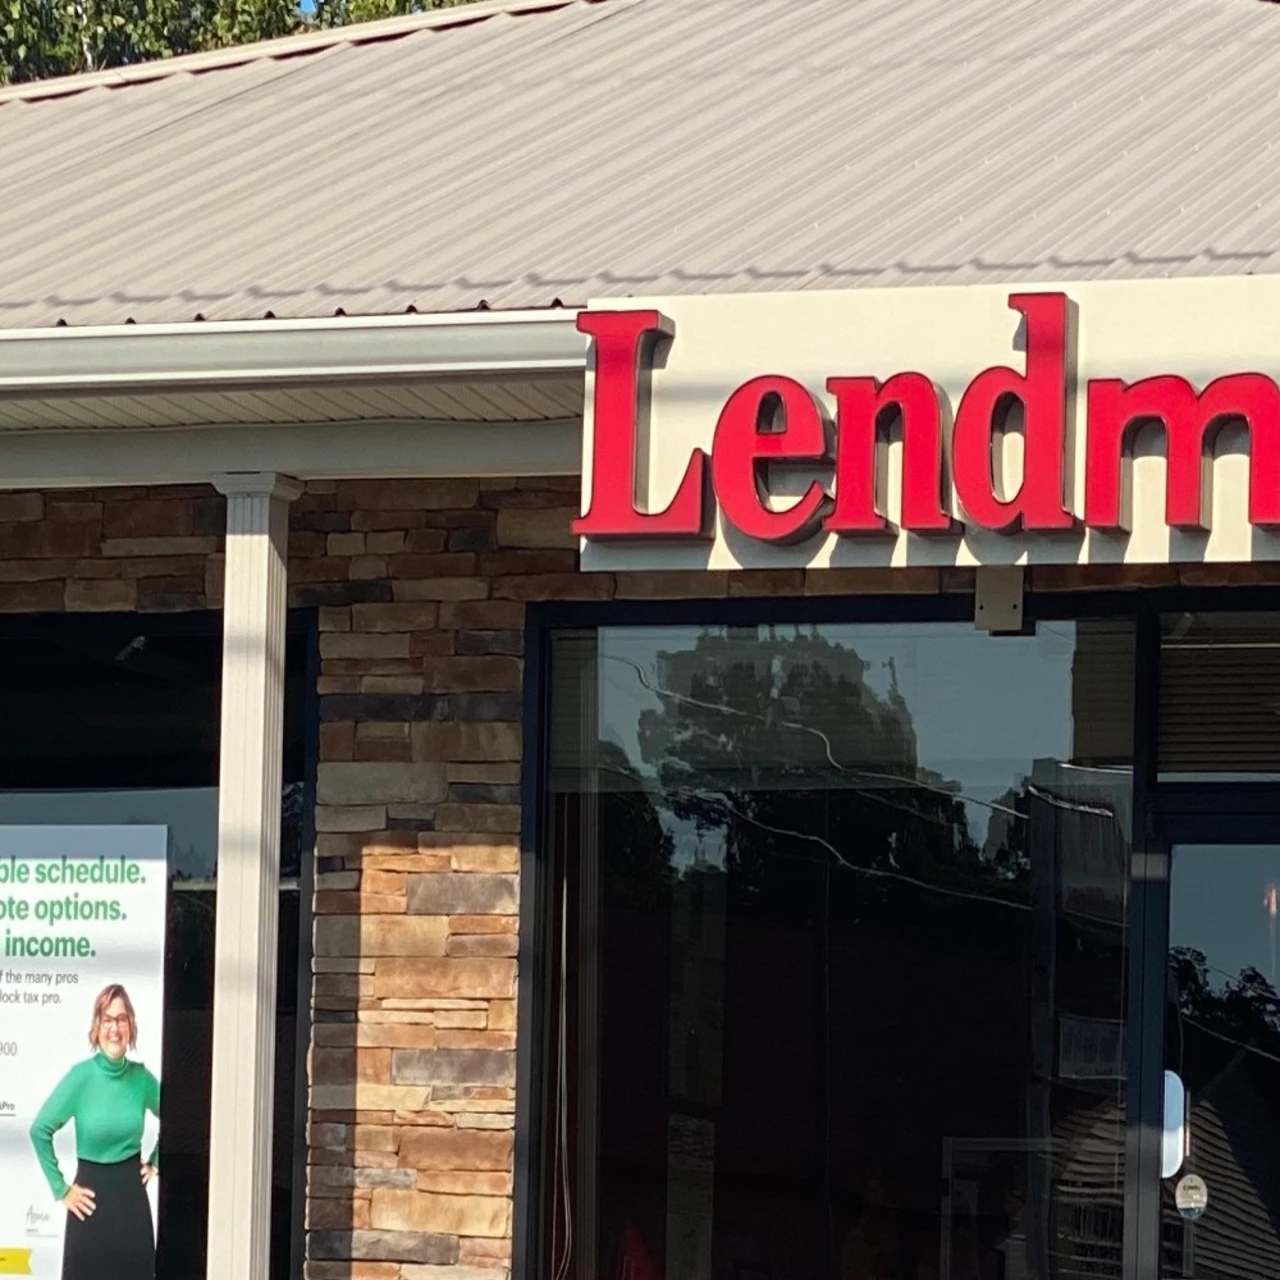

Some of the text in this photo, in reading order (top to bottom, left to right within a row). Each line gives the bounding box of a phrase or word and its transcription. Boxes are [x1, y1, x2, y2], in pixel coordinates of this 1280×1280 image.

[34, 855, 146, 884] schedule.
[34, 892, 127, 926] options.
[5, 929, 96, 958] income.
[5, 970, 22, 983] the
[24, 973, 53, 986] many
[55, 973, 79, 986] pros
[23, 992, 39, 1004] tax
[41, 993, 61, 1005] pro.
